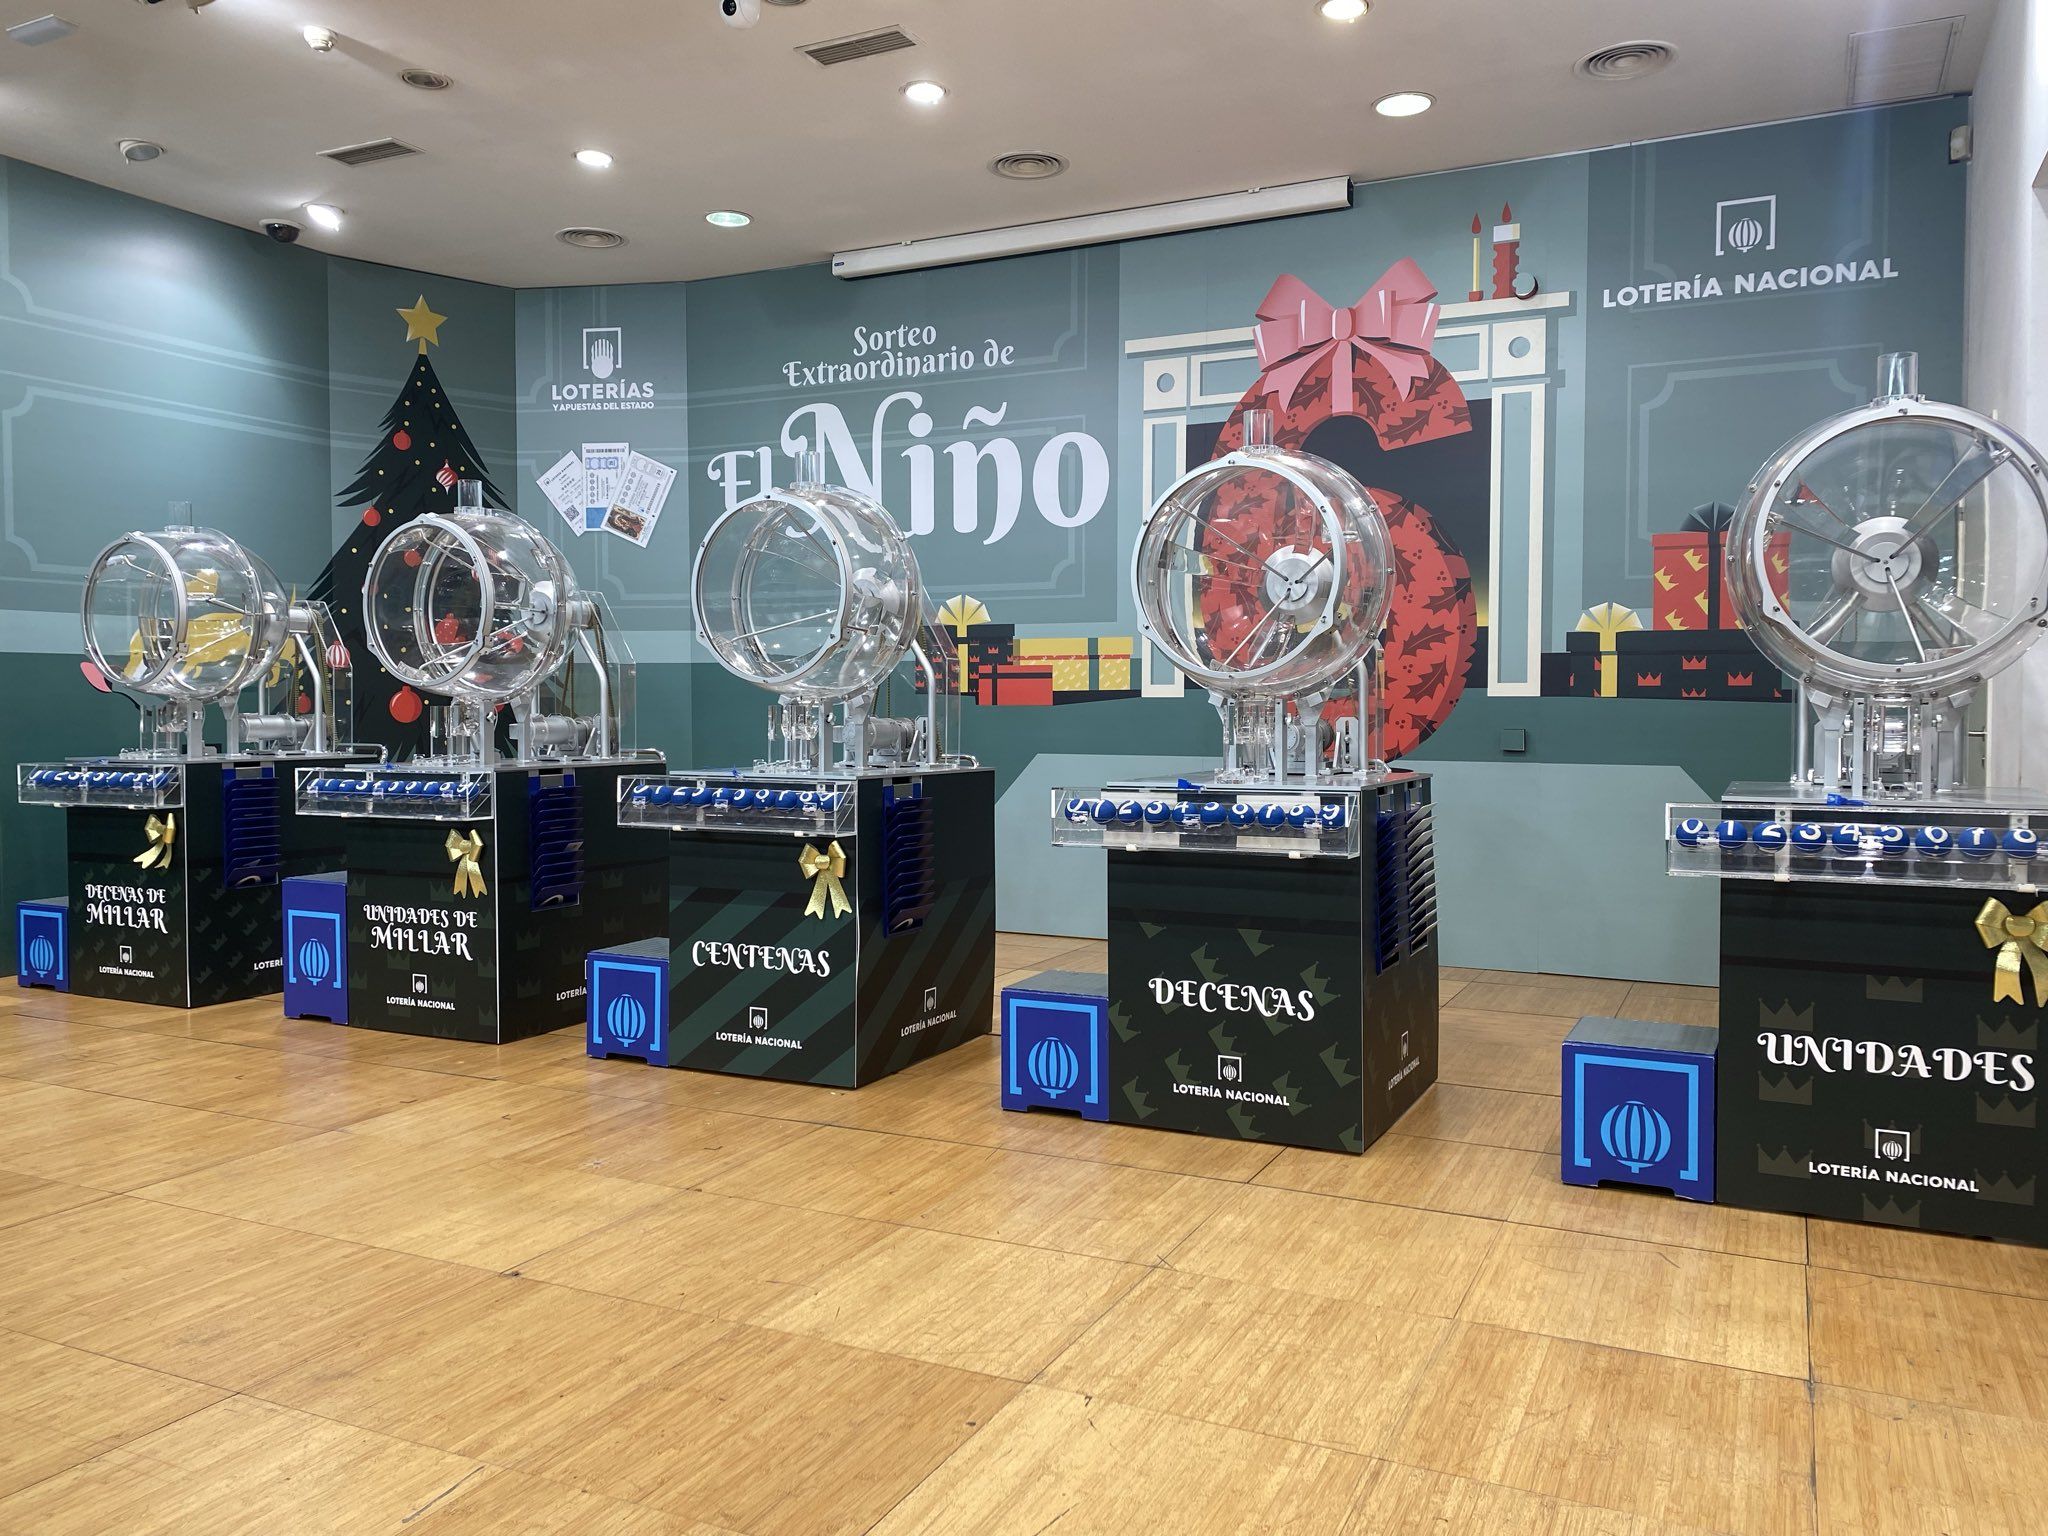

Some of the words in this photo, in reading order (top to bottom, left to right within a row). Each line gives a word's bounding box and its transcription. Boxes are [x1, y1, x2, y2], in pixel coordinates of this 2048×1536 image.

[1603, 275, 1723, 308] LOTERÍA
[1734, 258, 1899, 294] NACIONAL
[853, 324, 937, 356] Sorteo
[782, 346, 975, 387] Extraordinario
[984, 339, 1015, 367] de
[552, 379, 655, 400] LOTERÍAS
[553, 403, 559, 411] Y
[560, 402, 602, 411] APUESTAS
[603, 402, 619, 410] DEL
[621, 401, 655, 410] ESTADO
[707, 446, 772, 511] El
[780, 391, 1110, 545] Niño
[85, 884, 144, 904] DECENAS
[146, 888, 167, 904] DE
[86, 900, 169, 934] MILLAR
[363, 904, 449, 928] UNIDADES
[453, 910, 478, 928] DE
[371, 922, 474, 961] MILLAR
[99, 966, 123, 975] LOTERÍA
[124, 968, 155, 978] NACIONAL
[253, 956, 284, 970] LOTERÍ
[692, 940, 831, 978] CENTENAS
[387, 996, 416, 1007] LOTERÍA
[417, 1000, 456, 1011] NACIONAL
[556, 986, 587, 1001] LOTERÍA
[1148, 977, 1315, 1021] DECENAS
[901, 1020, 926, 1037] LOTERÍA
[927, 1010, 957, 1028] NACIONAL
[716, 1031, 753, 1044] LOTERÍA
[755, 1036, 803, 1049] NACIONAL
[1757, 1032, 2036, 1092] UNIDADES
[1173, 1083, 1222, 1098] LOTERÍA
[1226, 1090, 1290, 1106] NACIONAL
[1808, 1161, 1880, 1181] LOTERÍA
[1886, 1170, 1980, 1193] NACIONAL
